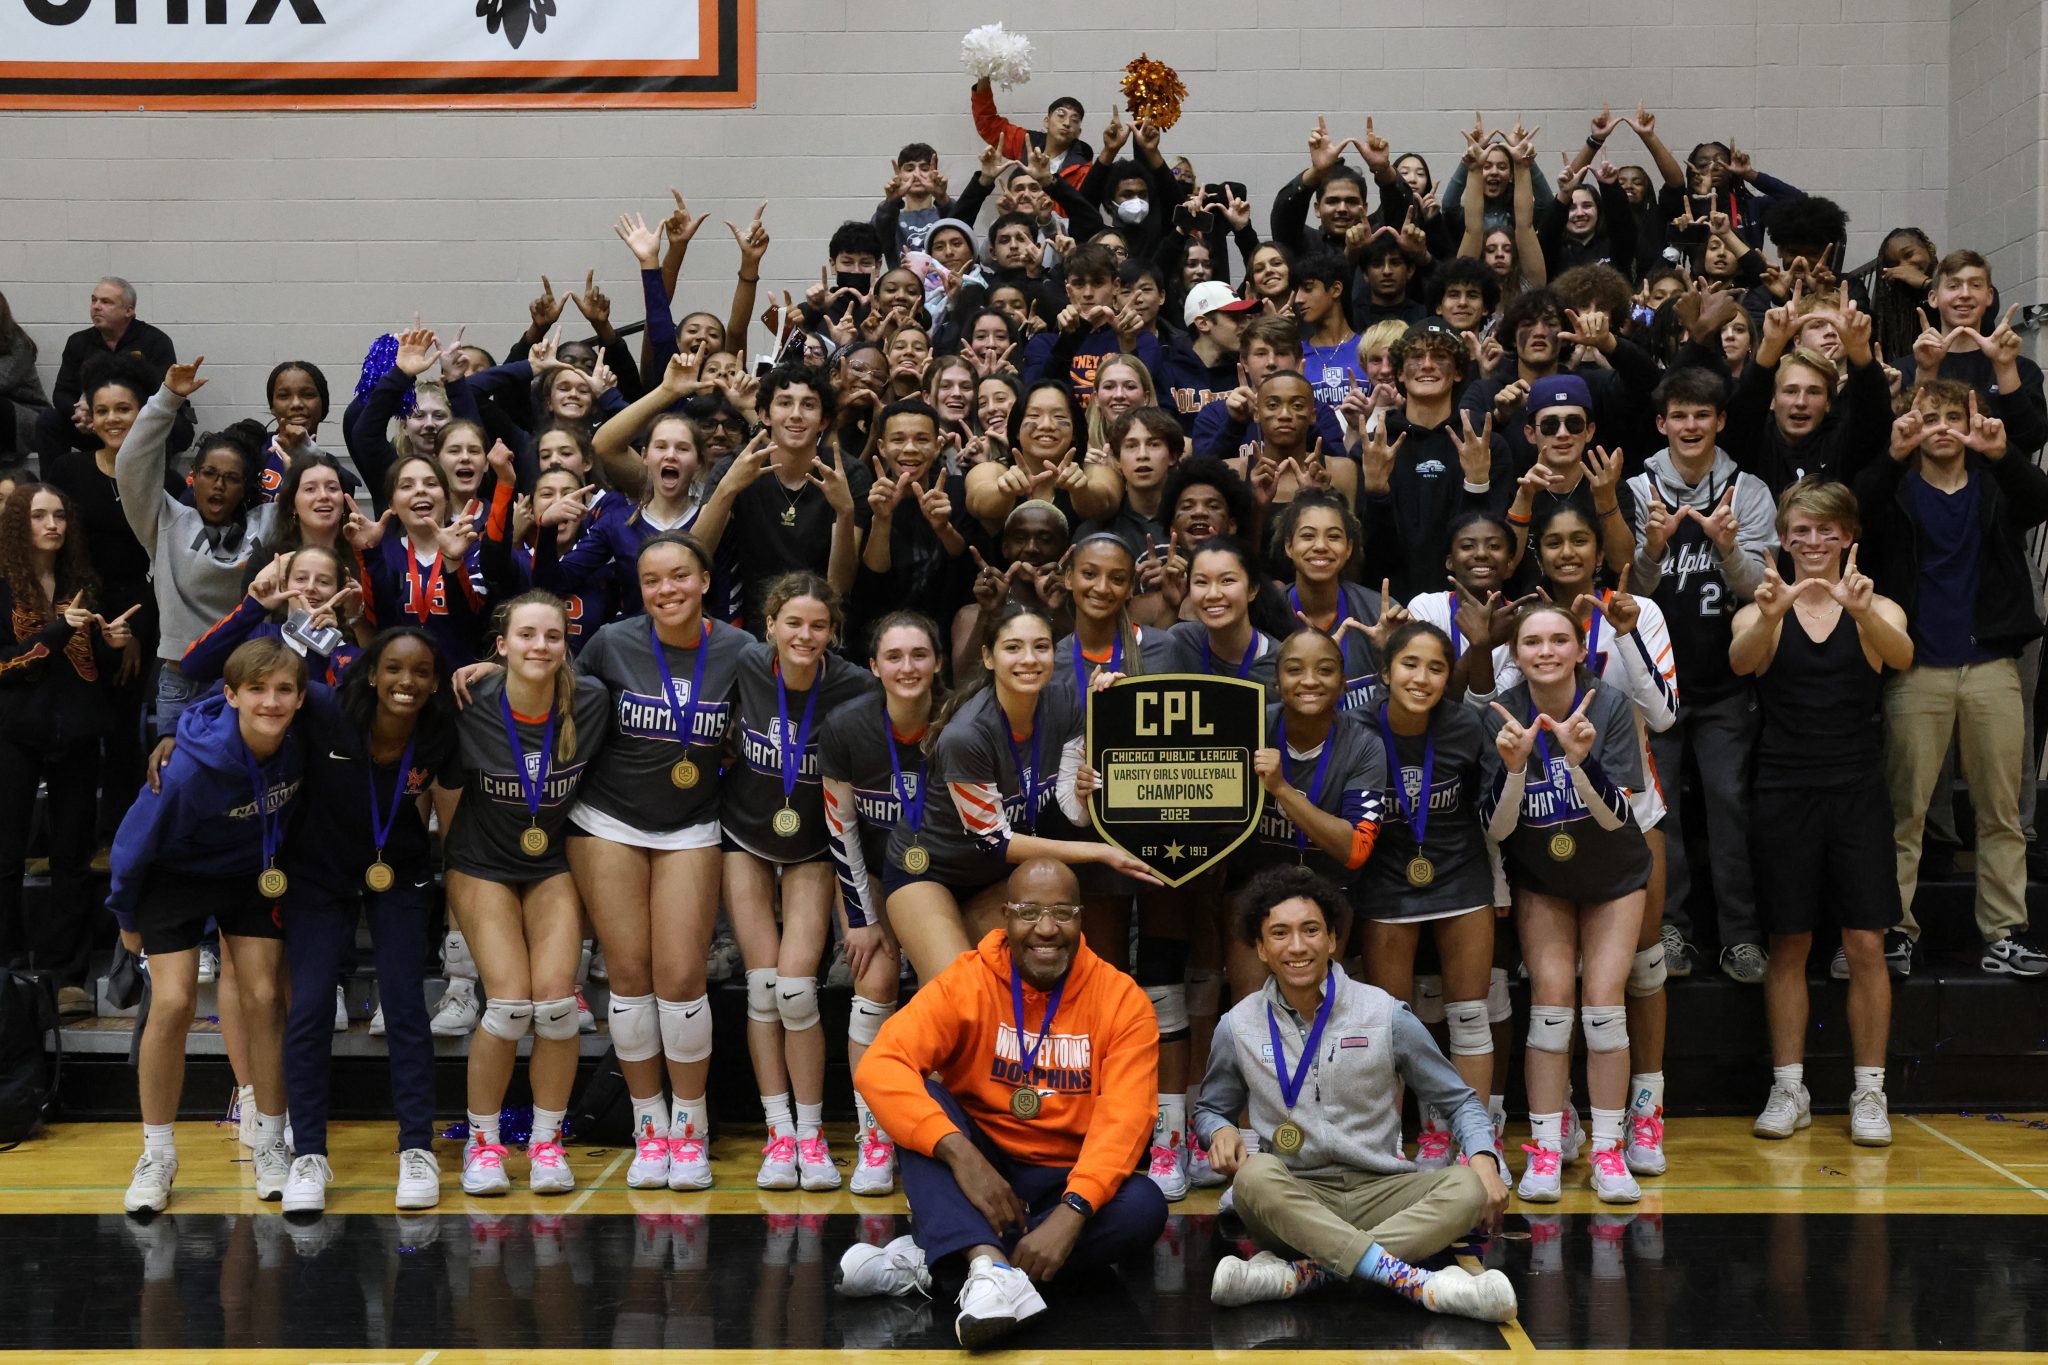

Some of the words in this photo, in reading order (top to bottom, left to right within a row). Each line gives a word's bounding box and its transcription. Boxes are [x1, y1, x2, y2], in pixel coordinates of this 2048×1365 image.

[1700, 582, 1722, 616] 2
[673, 682, 686, 696] PL
[621, 700, 726, 738] CHAMONS
[1135, 691, 1215, 736] CPL
[1112, 751, 1155, 762] CHICAGO
[1159, 751, 1195, 762] PUBLIC
[1200, 750, 1239, 761] LEAGUE
[1113, 768, 1151, 781] VARSITY
[1153, 768, 1179, 780] GIRLS
[1181, 767, 1238, 780] VOLLEYBALL
[901, 776, 915, 789] PL
[1137, 784, 1214, 801] CHAMPIONS
[1160, 808, 1190, 821] 2022
[1141, 846, 1157, 857] EST
[1189, 846, 1208, 857] 1913
[1053, 1038, 1091, 1069] YOUNG
